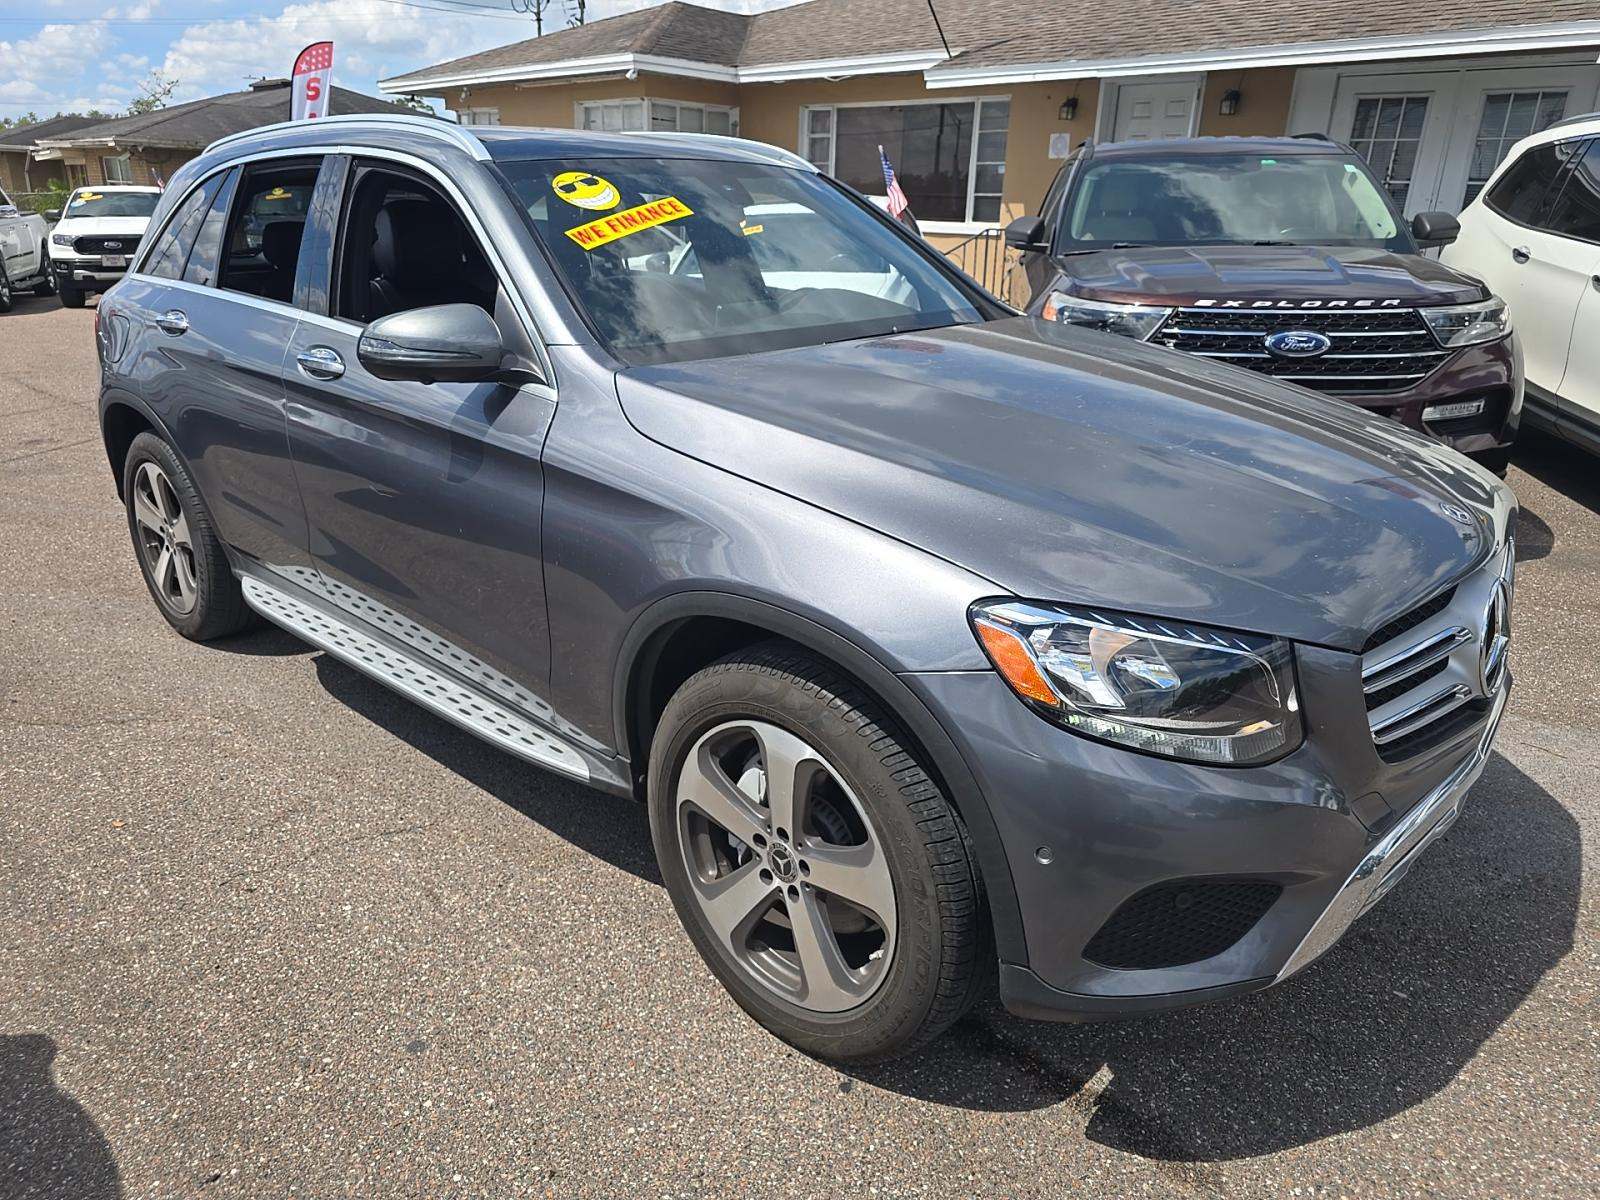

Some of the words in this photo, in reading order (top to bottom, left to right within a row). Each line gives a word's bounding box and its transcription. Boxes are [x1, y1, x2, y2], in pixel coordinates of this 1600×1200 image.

[572, 225, 605, 244] WE
[605, 200, 683, 233] FINANCE
[1194, 299, 1401, 308] EXPLORER
[1280, 336, 1317, 350] Ford
